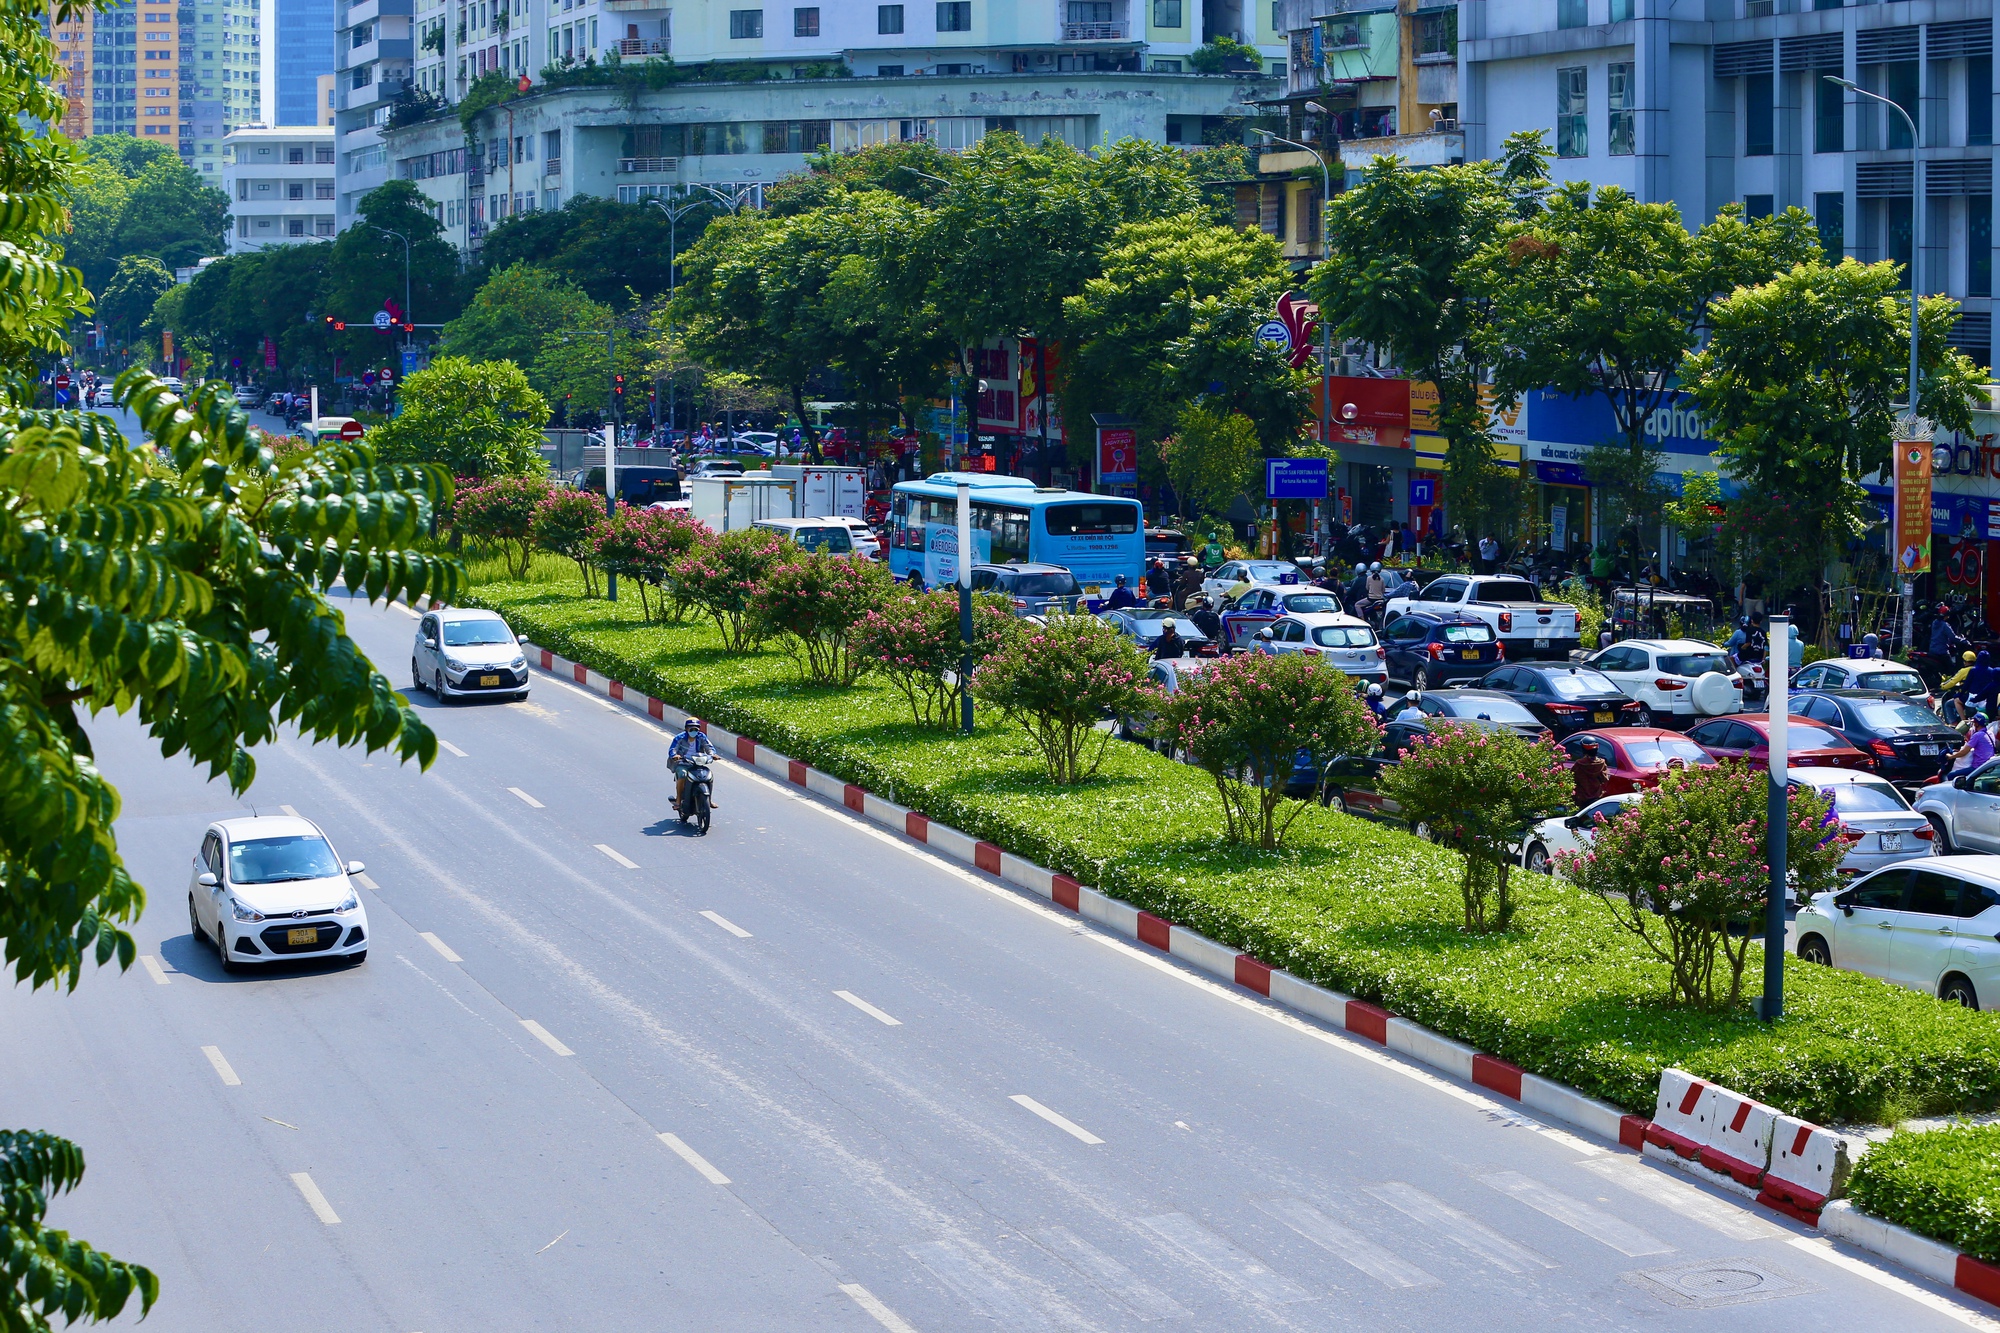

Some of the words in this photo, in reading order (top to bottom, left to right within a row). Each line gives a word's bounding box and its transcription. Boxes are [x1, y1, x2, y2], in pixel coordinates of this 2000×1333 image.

[1411, 388, 1425, 399] BƯU
[935, 540, 959, 553] AEROFLO
[1855, 646, 1865, 657] G7
